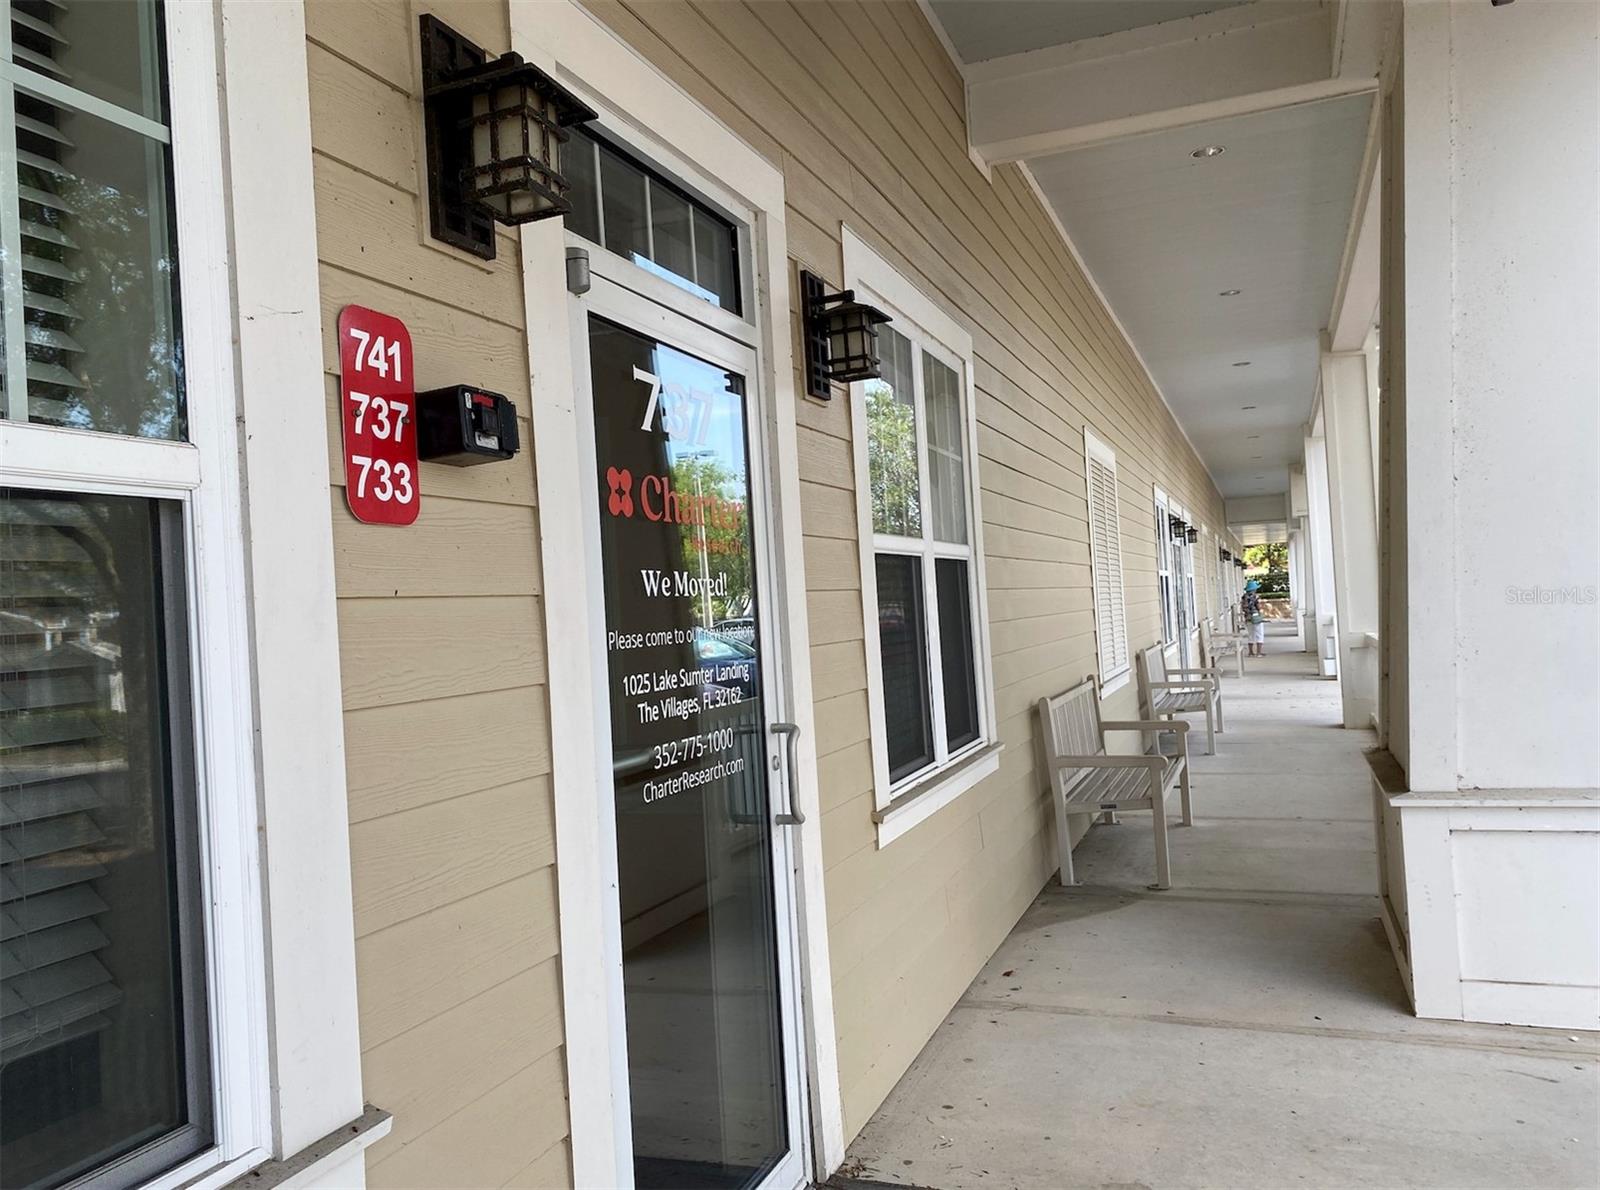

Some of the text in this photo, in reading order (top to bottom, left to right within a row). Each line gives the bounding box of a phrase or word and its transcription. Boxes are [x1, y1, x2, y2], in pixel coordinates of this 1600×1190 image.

[350, 328, 402, 382] 741
[350, 391, 409, 442] 737
[633, 364, 712, 446] 737
[352, 455, 413, 504] 733
[640, 475, 744, 529] Charter
[641, 569, 728, 597] We Moved!
[608, 631, 643, 650] Please
[645, 630, 672, 647] come
[674, 628, 685, 643] to
[623, 661, 750, 696] 1025 Lake Sumter Landing
[637, 686, 742, 723] The Villages, FL 32162
[653, 727, 734, 769] 352-775-1000
[643, 758, 745, 803] CharterResearch.com
